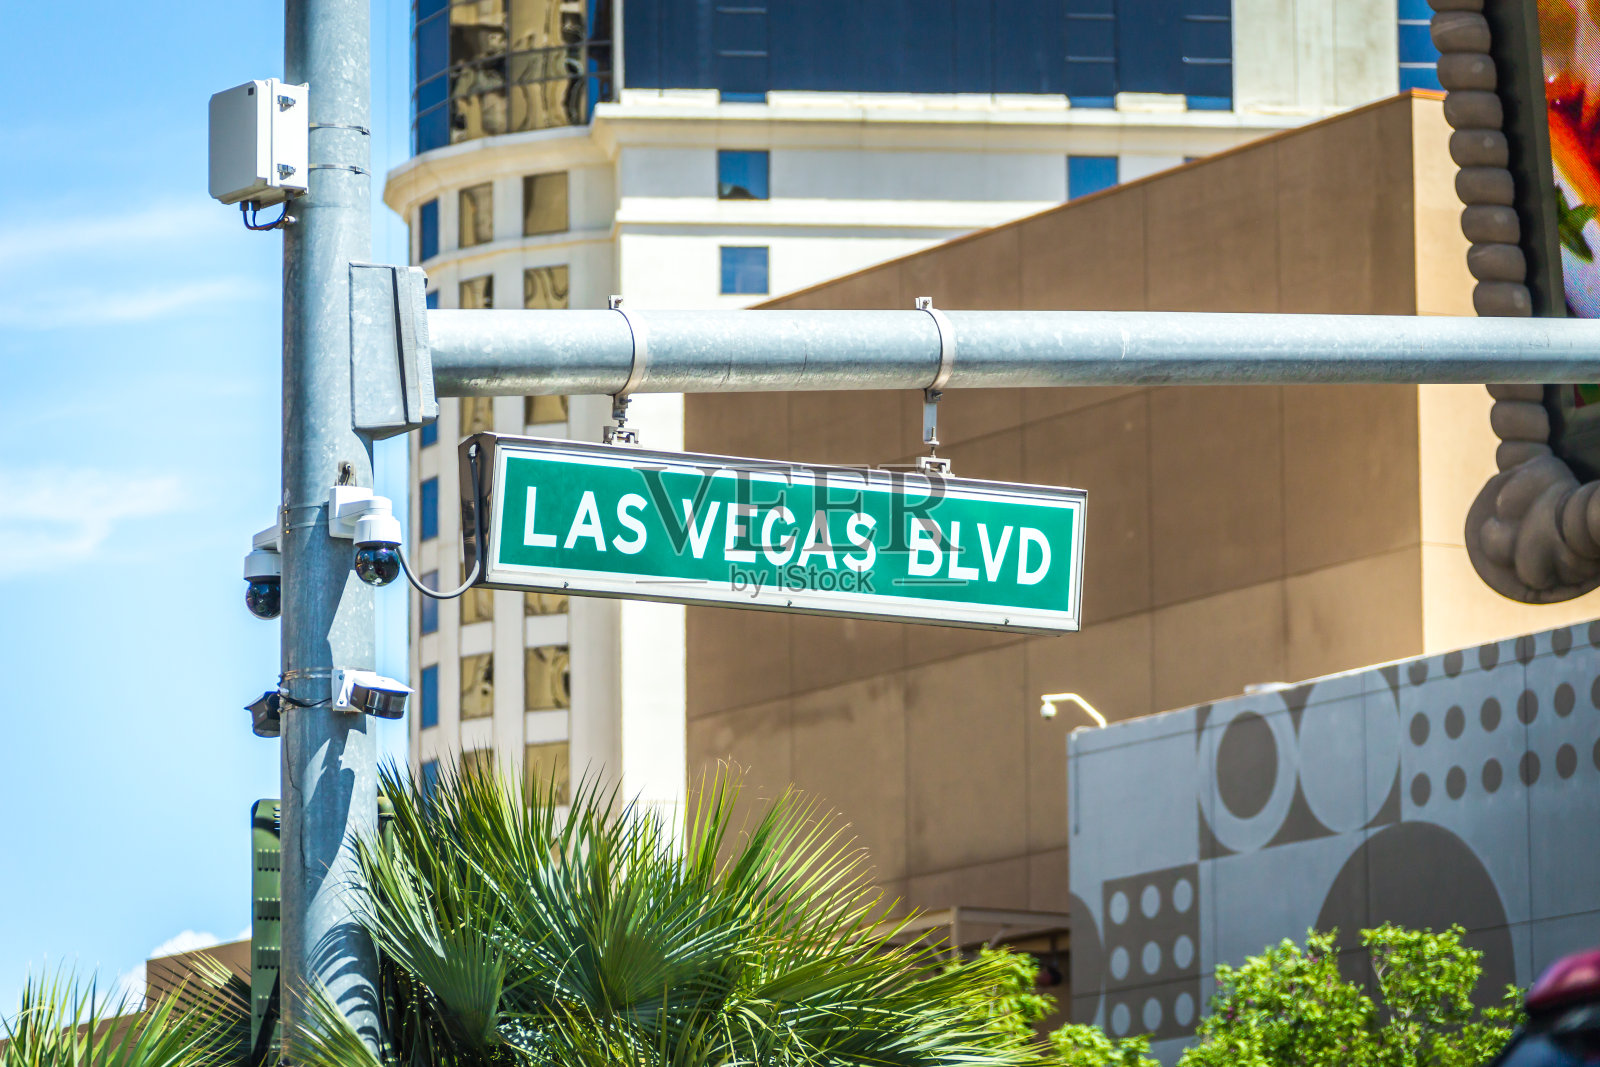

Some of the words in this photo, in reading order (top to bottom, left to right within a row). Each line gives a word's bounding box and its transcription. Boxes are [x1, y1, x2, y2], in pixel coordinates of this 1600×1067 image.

[523, 486, 648, 555] LAS
[682, 499, 877, 572] VEGAS
[908, 519, 1052, 585] BLVD
